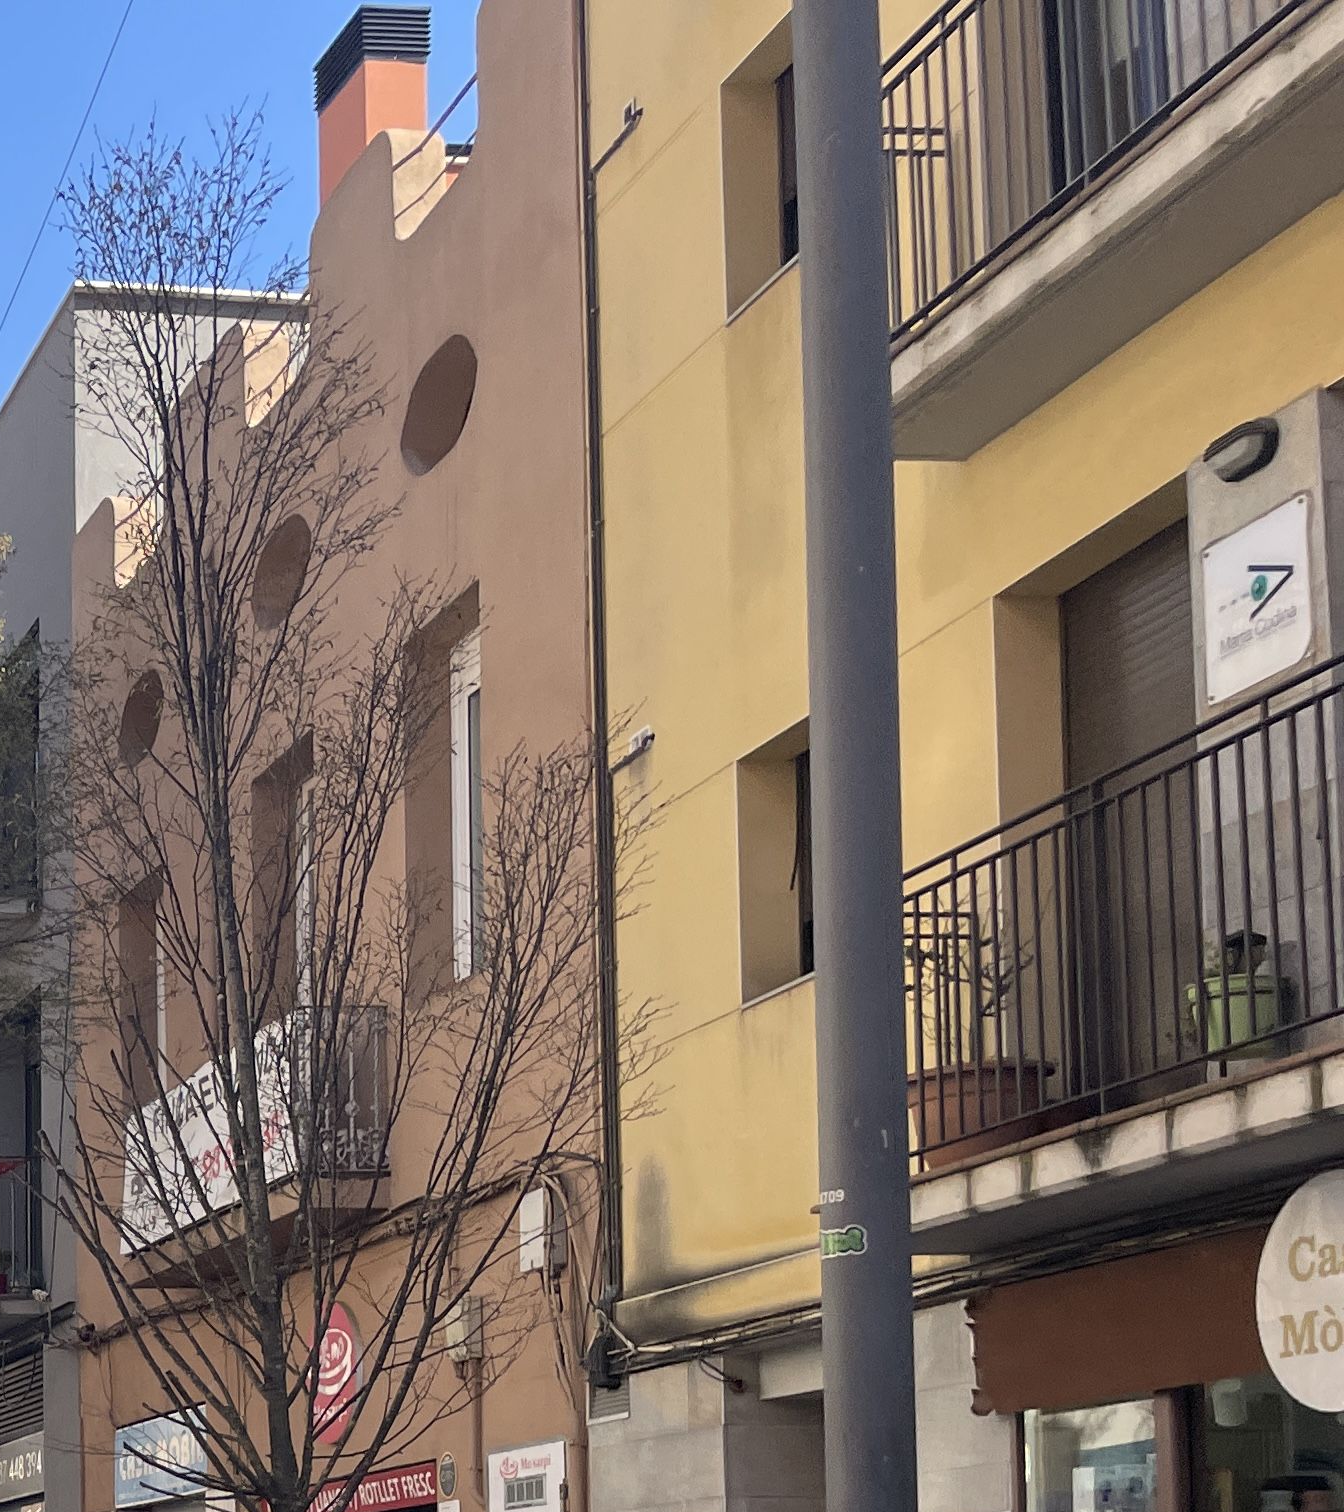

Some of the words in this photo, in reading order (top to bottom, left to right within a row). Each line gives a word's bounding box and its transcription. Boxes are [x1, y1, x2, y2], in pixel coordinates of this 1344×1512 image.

[1288, 1234, 1344, 1283] Ca
[1279, 1304, 1344, 1358] Mò
[9, 1455, 24, 1480] 448
[360, 1477, 400, 1506] ROTLLET
[401, 1471, 435, 1499] FRESC
